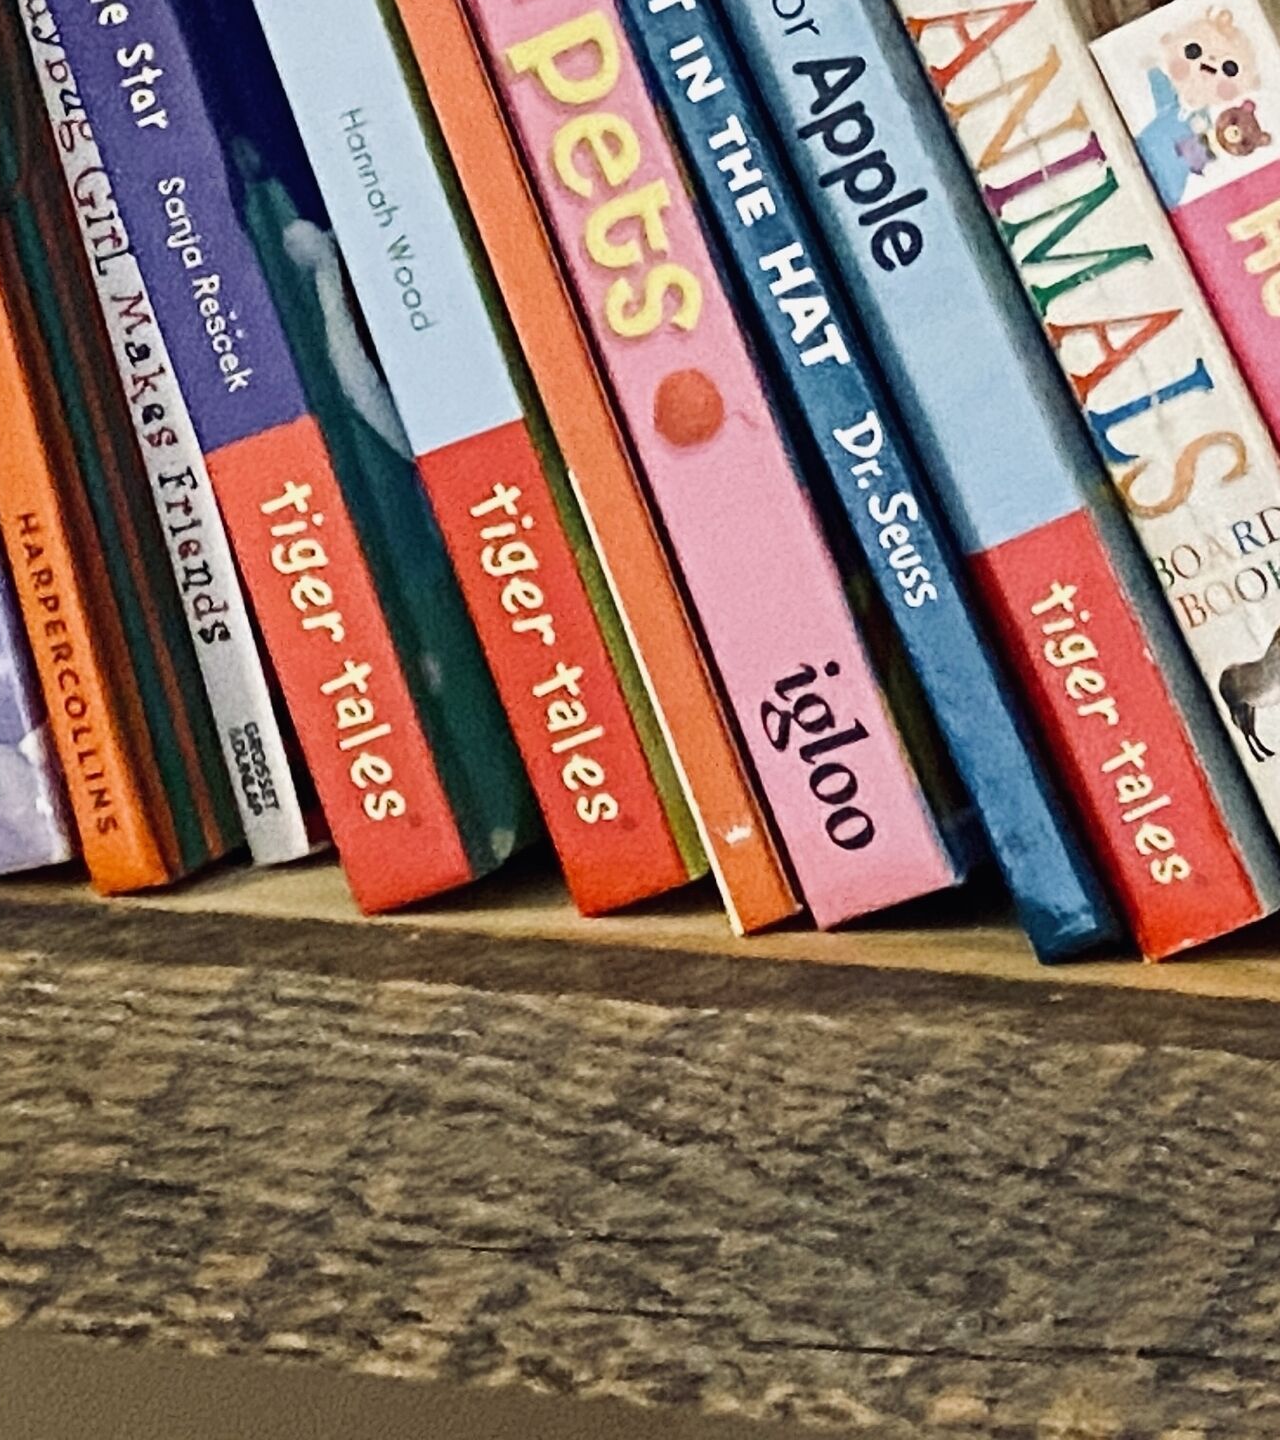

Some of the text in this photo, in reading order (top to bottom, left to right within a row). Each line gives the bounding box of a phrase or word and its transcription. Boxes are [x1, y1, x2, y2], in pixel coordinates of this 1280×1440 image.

[117, 41, 169, 130] Star
[668, 35, 726, 104] IN
[706, 113, 777, 227] THE
[759, 241, 851, 368] HAT
[792, 55, 928, 273] Apple
[157, 176, 205, 270] Sanja
[339, 106, 439, 332] Hannah Wood
[109, 290, 179, 448] Makes
[157, 465, 232, 646] Friends
[833, 410, 939, 609] Dr. Seuss
[18, 511, 121, 837] HARPERCOLLINS
[261, 480, 407, 822] tiger tales
[469, 481, 619, 826] tiger tales
[759, 660, 877, 853] igloo
[1031, 579, 1194, 886] tiger tales
